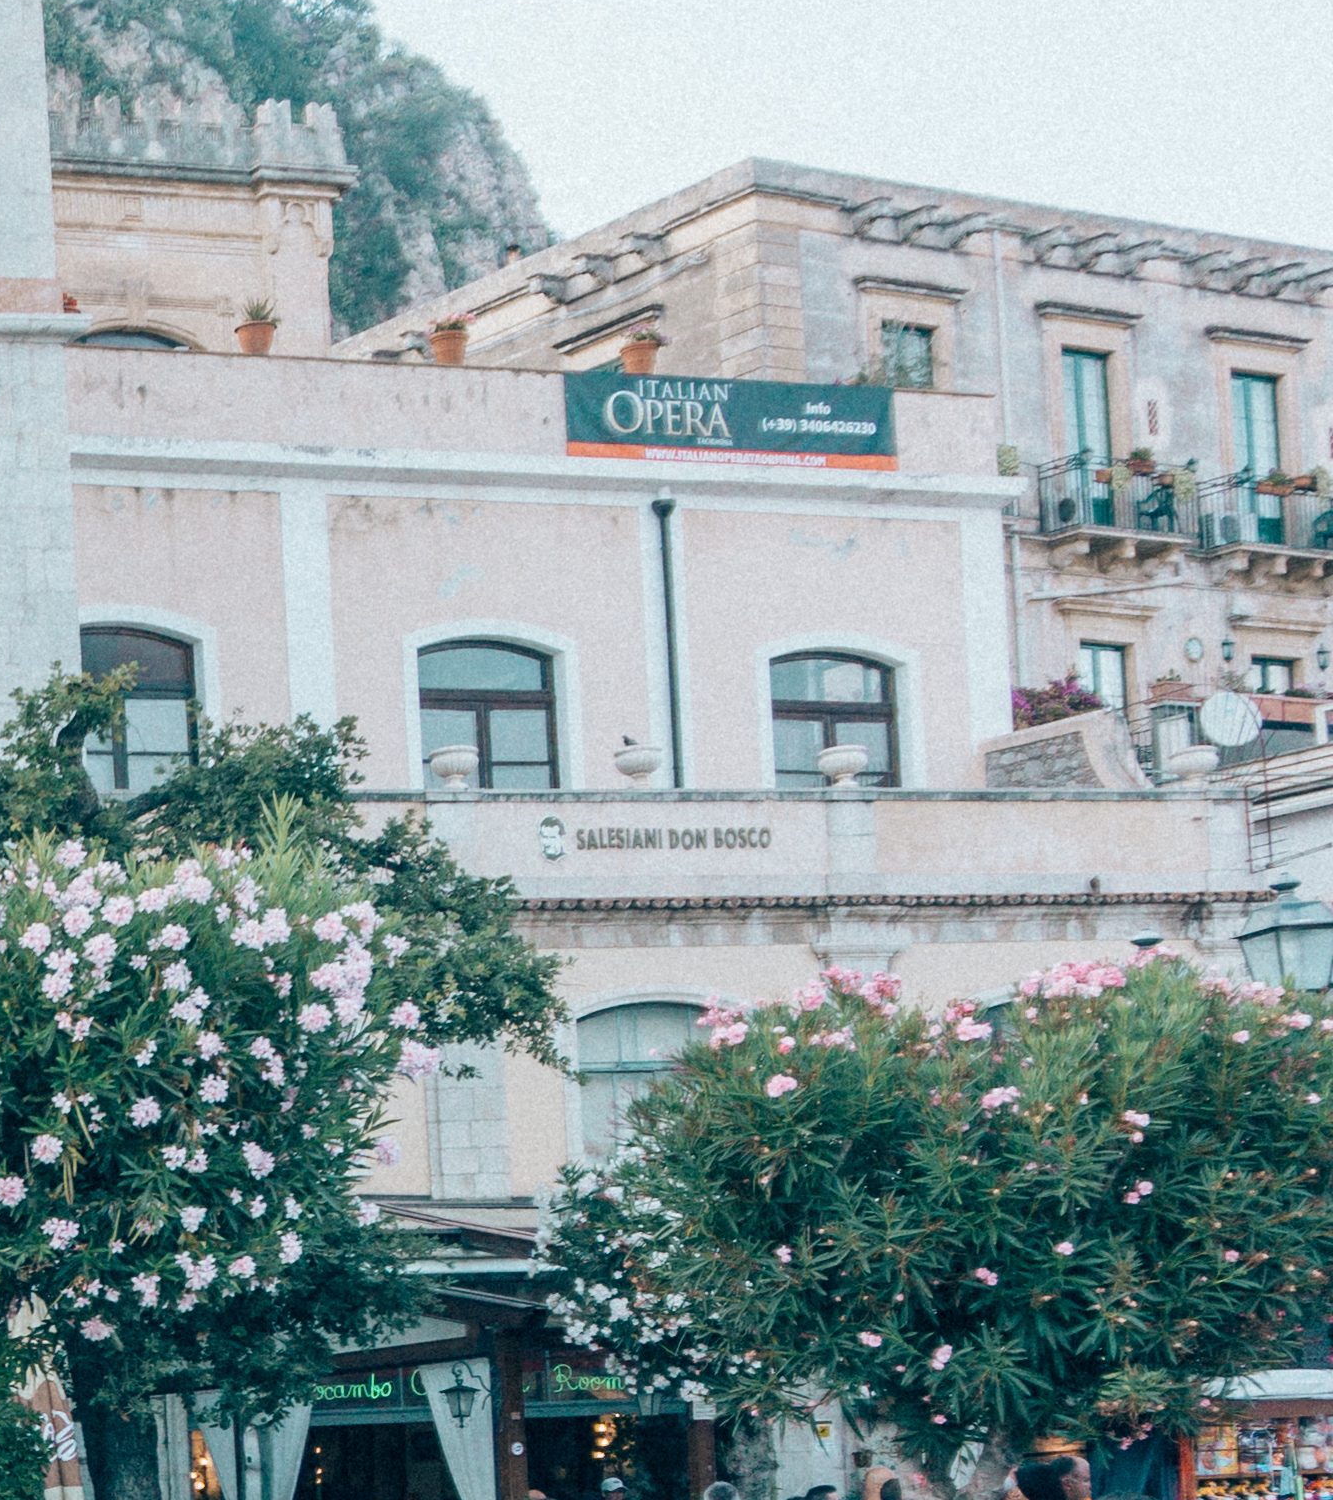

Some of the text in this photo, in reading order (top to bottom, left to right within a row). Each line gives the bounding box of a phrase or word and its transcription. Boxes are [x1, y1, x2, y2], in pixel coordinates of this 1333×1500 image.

[638, 379, 729, 401] ITALIAN
[606, 390, 732, 438] OPERA
[806, 401, 832, 416] Info
[762, 417, 877, 435] (+39) 3406426230
[576, 826, 772, 851] SALESIANI DON BOSCO
[553, 1363, 626, 1393] Room
